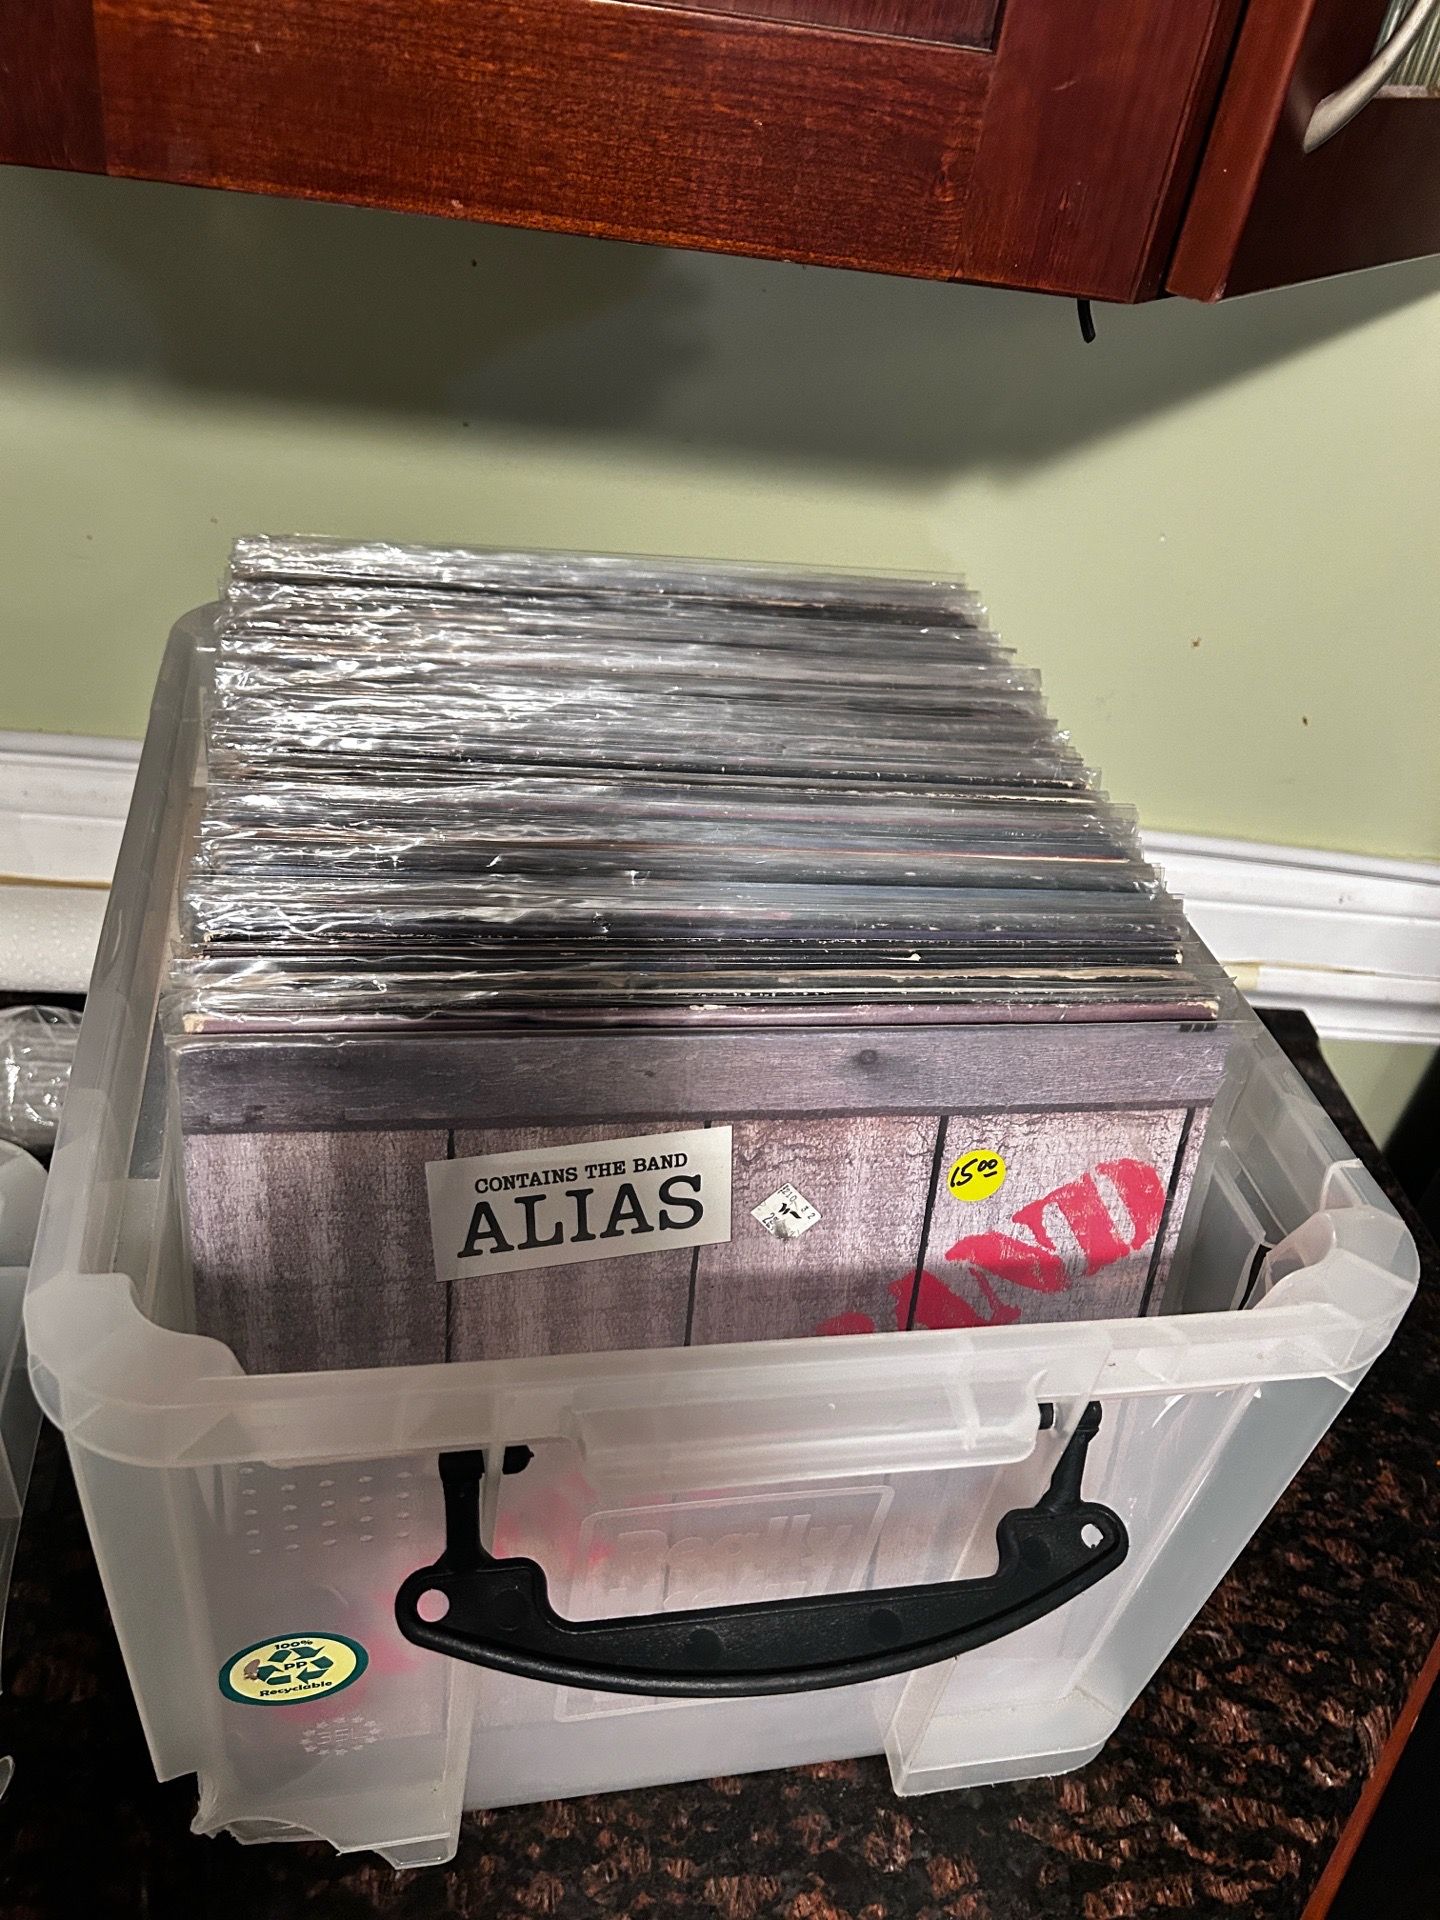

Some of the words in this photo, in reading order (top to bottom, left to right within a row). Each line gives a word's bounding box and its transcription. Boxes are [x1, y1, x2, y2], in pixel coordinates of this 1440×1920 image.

[474, 1167, 578, 1194] CONTAINS
[585, 1160, 626, 1180] THE
[633, 1152, 688, 1175] BAND
[456, 1174, 704, 1258] ALIAS
[274, 1638, 313, 1650] 100%
[259, 1680, 333, 1697] Recyclable
